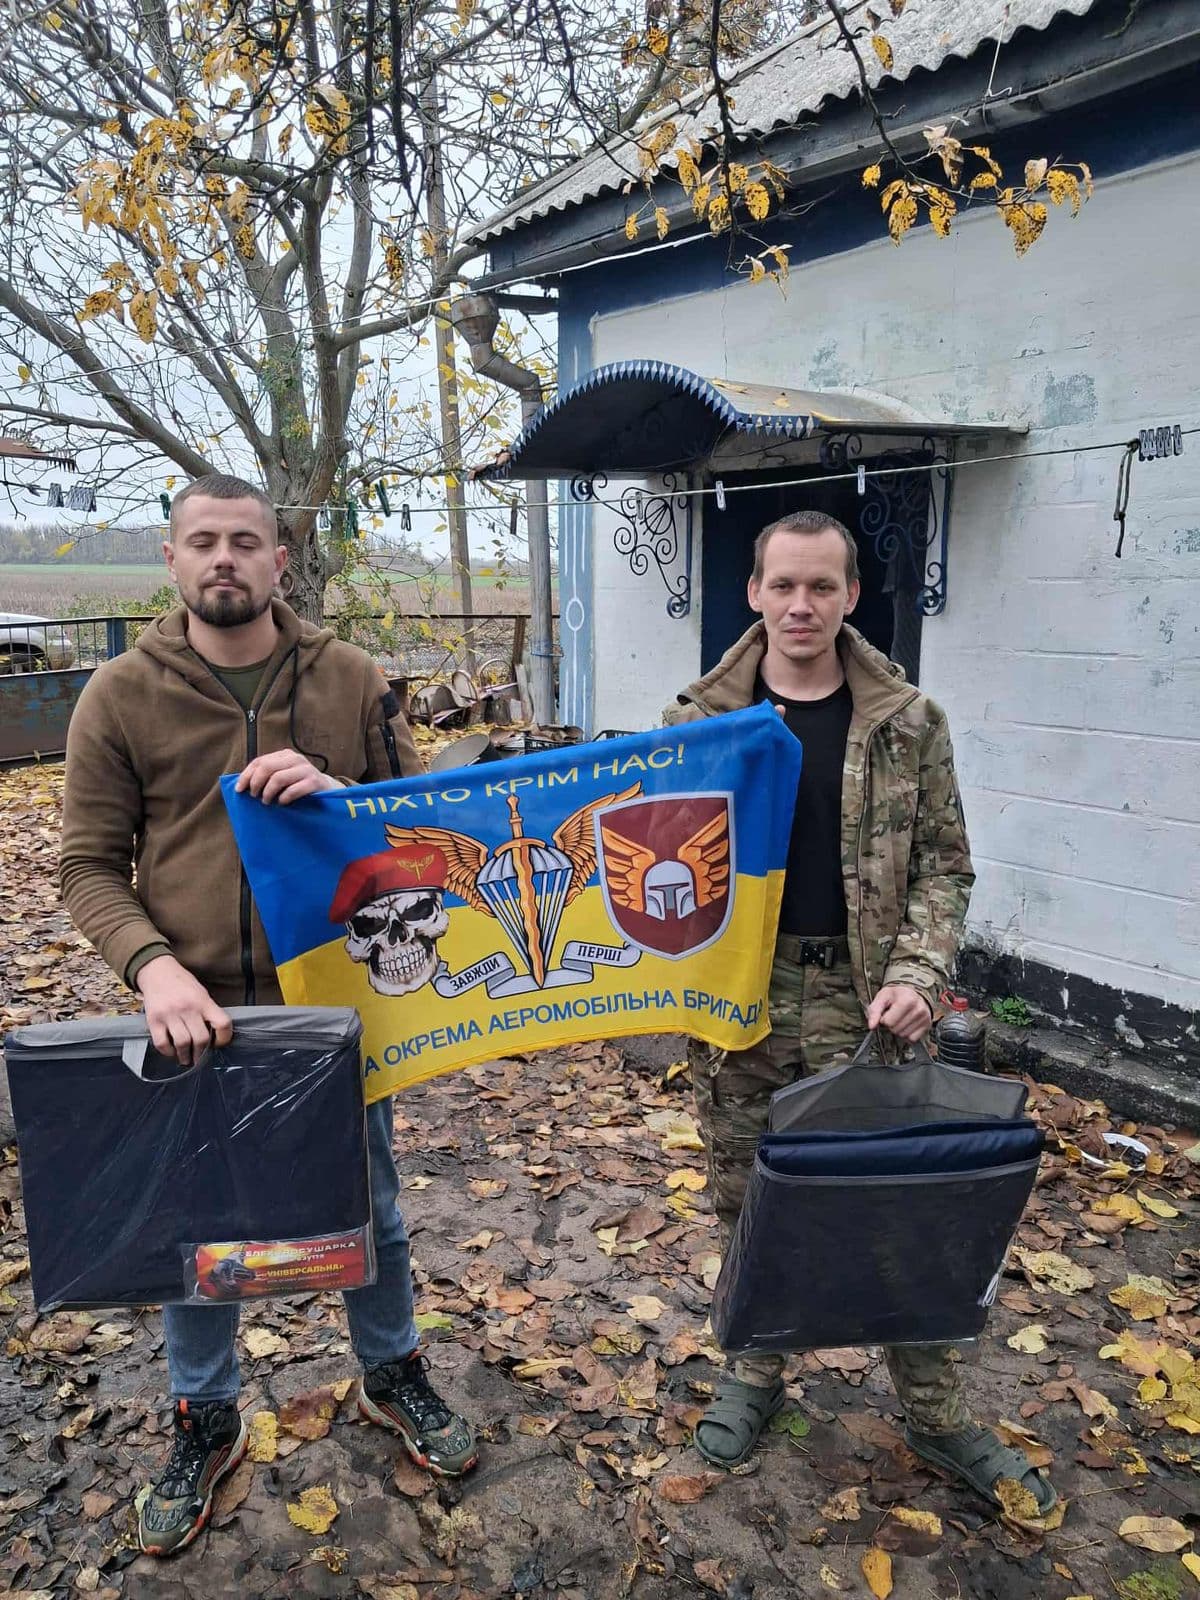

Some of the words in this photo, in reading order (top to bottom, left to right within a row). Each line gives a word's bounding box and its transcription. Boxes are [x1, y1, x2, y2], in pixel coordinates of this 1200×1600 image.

[346, 788, 471, 819] НІХТО
[485, 767, 579, 797] КРІМ
[593, 744, 684, 778] НАС!
[450, 957, 500, 991] ЗАВЖДИ
[577, 945, 622, 962] ПЕРШІ
[384, 1020, 483, 1065] ОКРЕМА
[488, 990, 678, 1034] АЕРОМОБІЛЬНА
[245, 1241, 356, 1257] ЕЛЕКРОСУШАРКА
